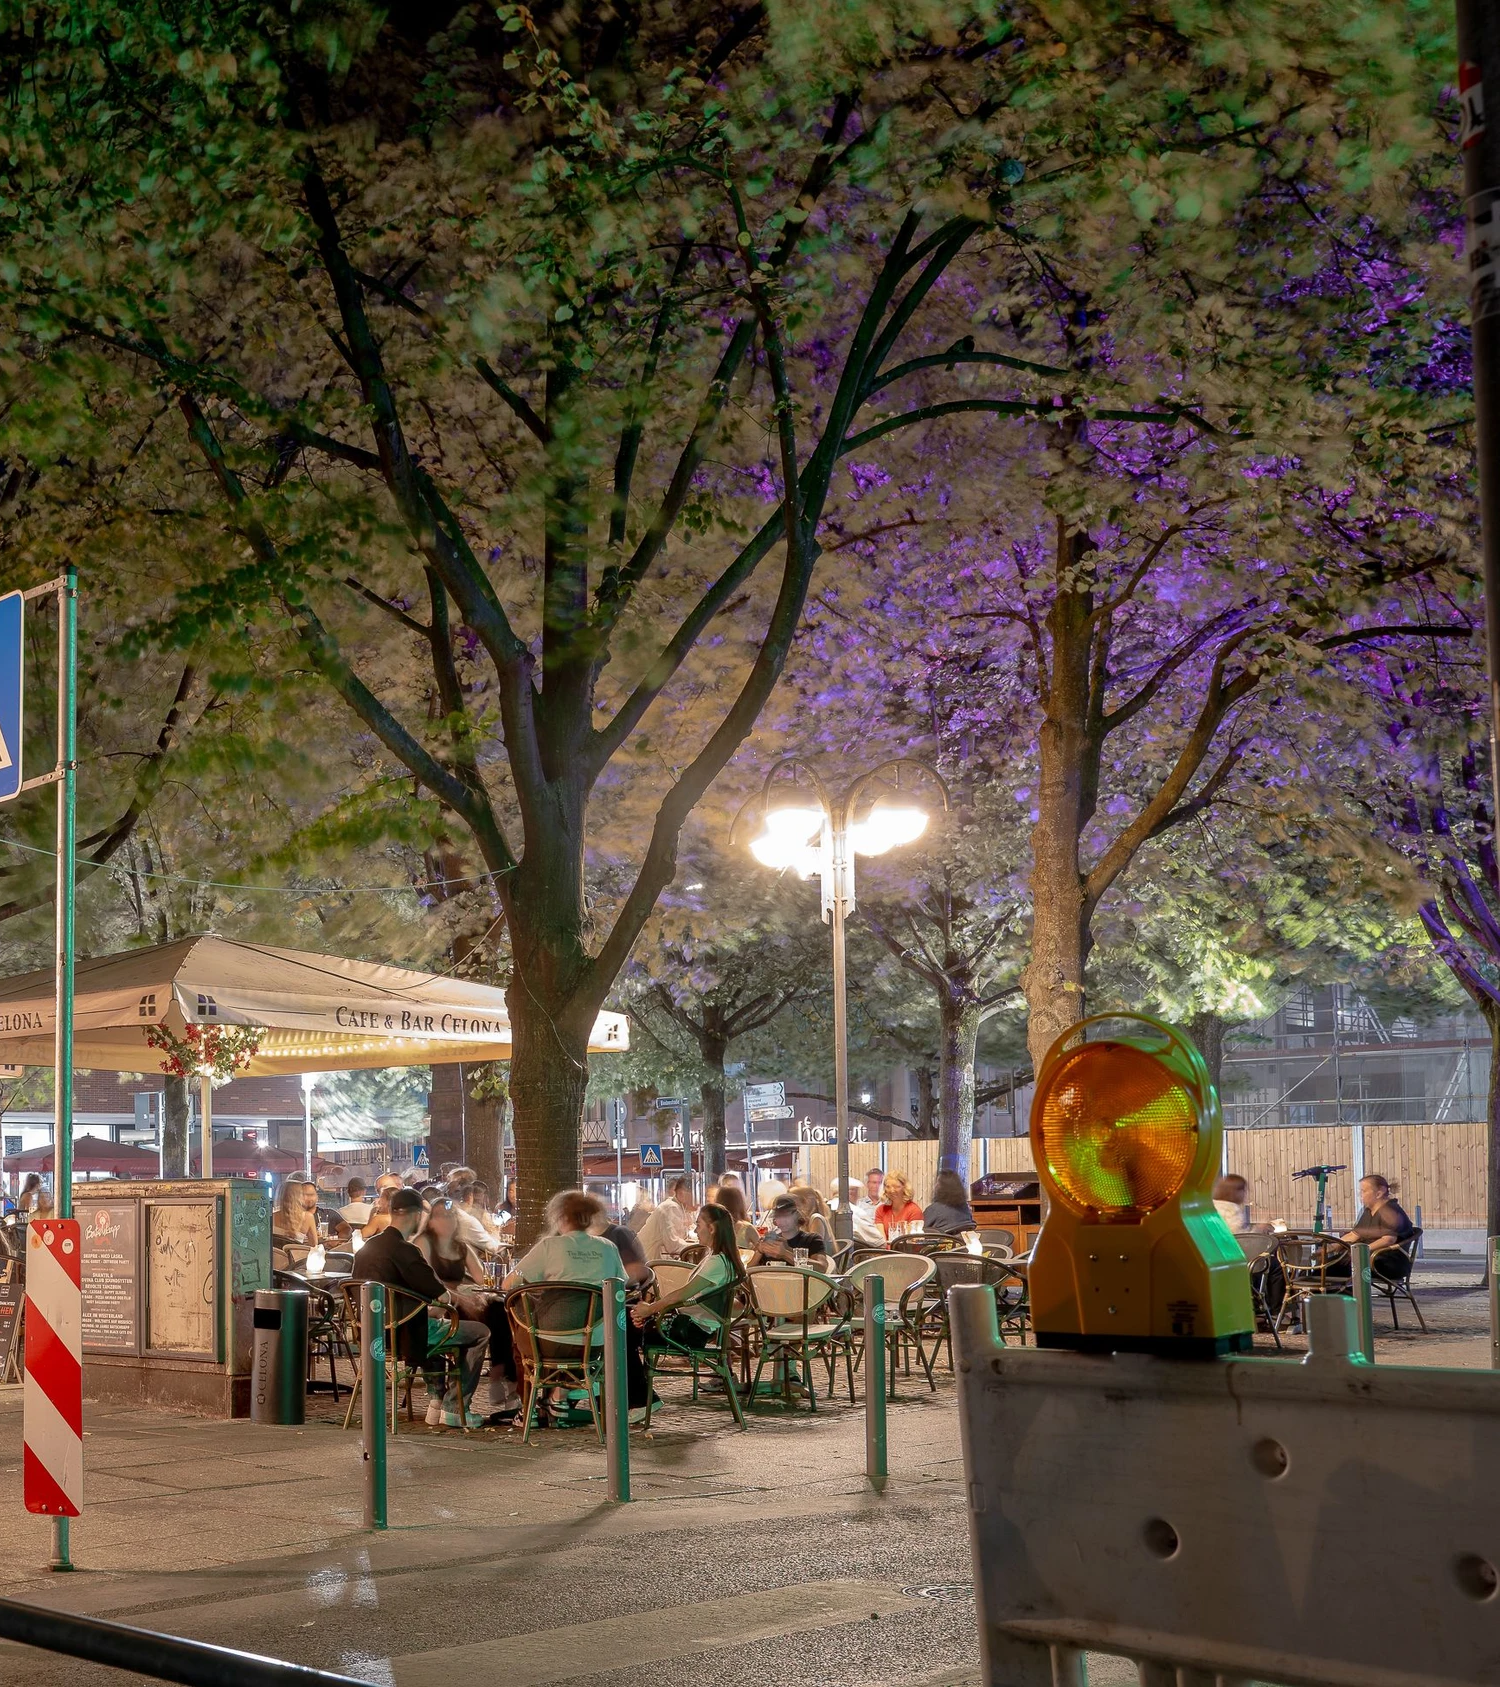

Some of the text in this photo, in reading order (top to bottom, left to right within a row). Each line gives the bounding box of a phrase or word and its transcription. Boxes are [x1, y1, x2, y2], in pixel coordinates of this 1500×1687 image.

[336, 1005, 501, 1035] CAFE & BAR CELONA
[259, 1340, 269, 1391] CELONA
